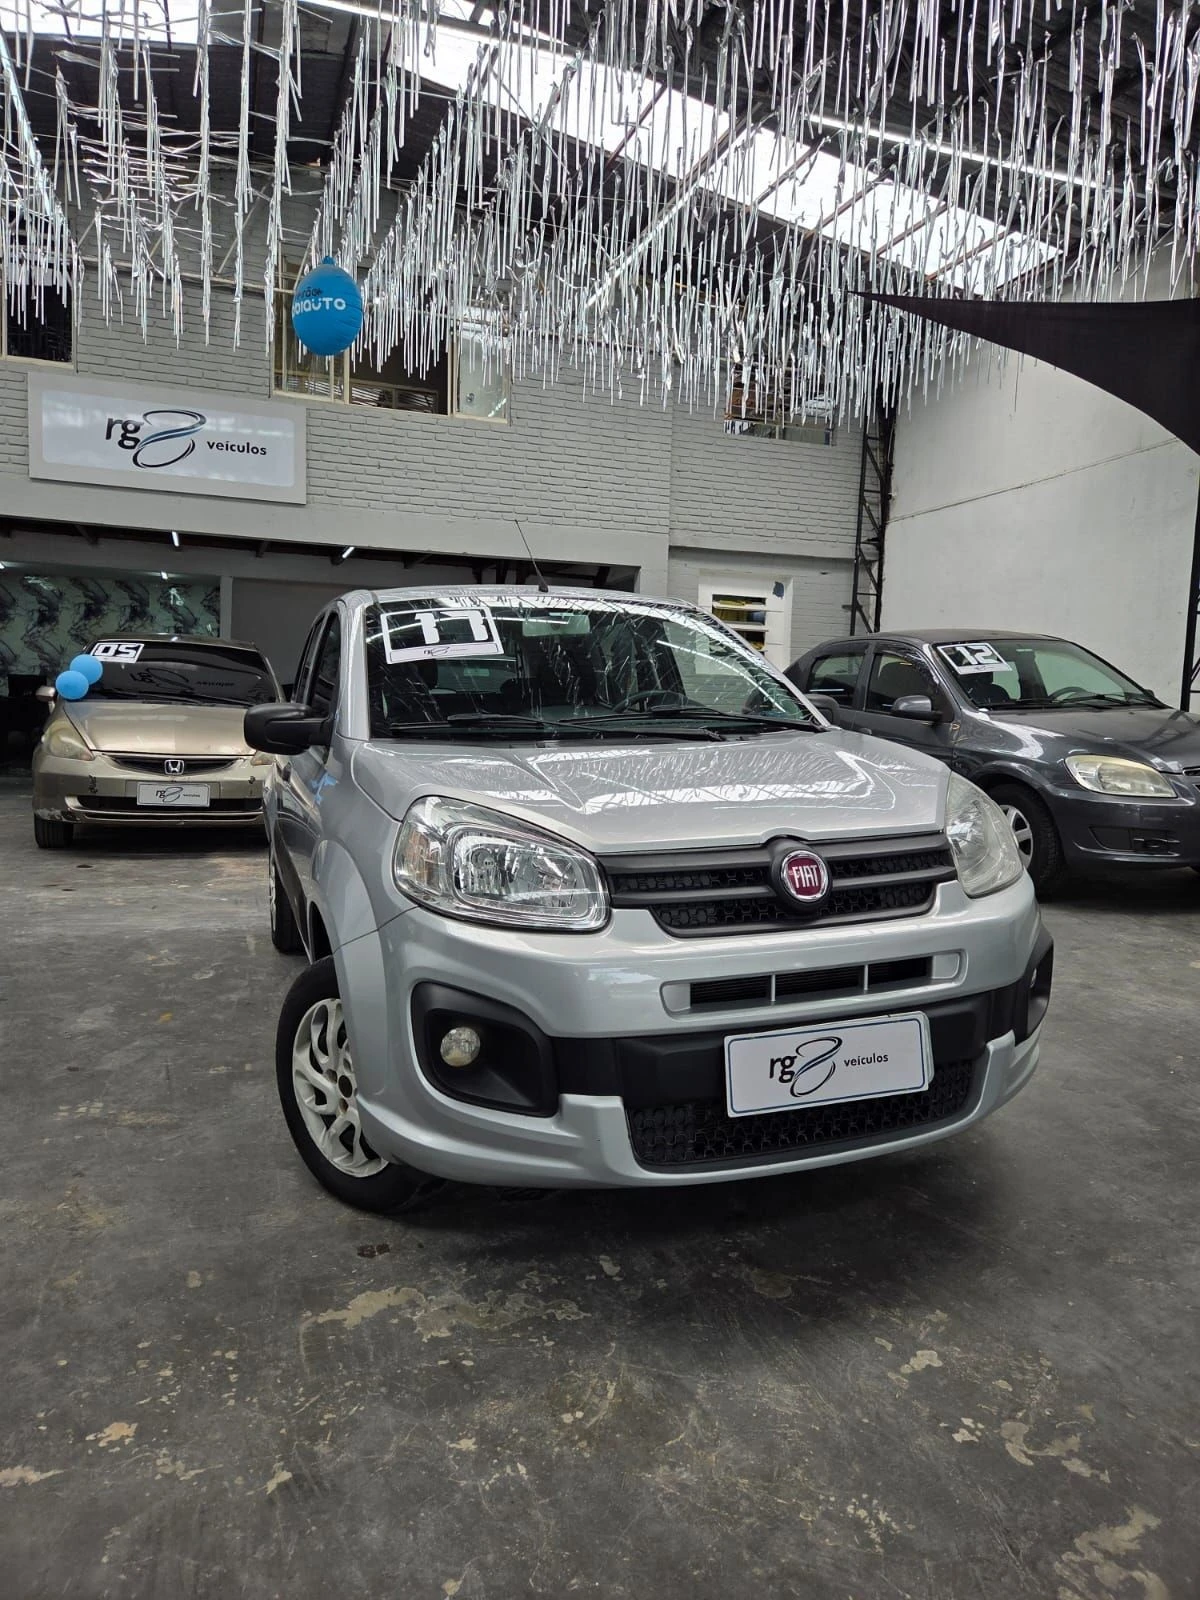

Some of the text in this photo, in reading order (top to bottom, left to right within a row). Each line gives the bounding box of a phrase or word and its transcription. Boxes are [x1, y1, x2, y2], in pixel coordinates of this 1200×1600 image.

[206, 441, 267, 456] veículos
[415, 610, 489, 645] 17
[956, 646, 1000, 665] 12
[791, 864, 819, 889] FIAT
[843, 1052, 889, 1067] veículos
